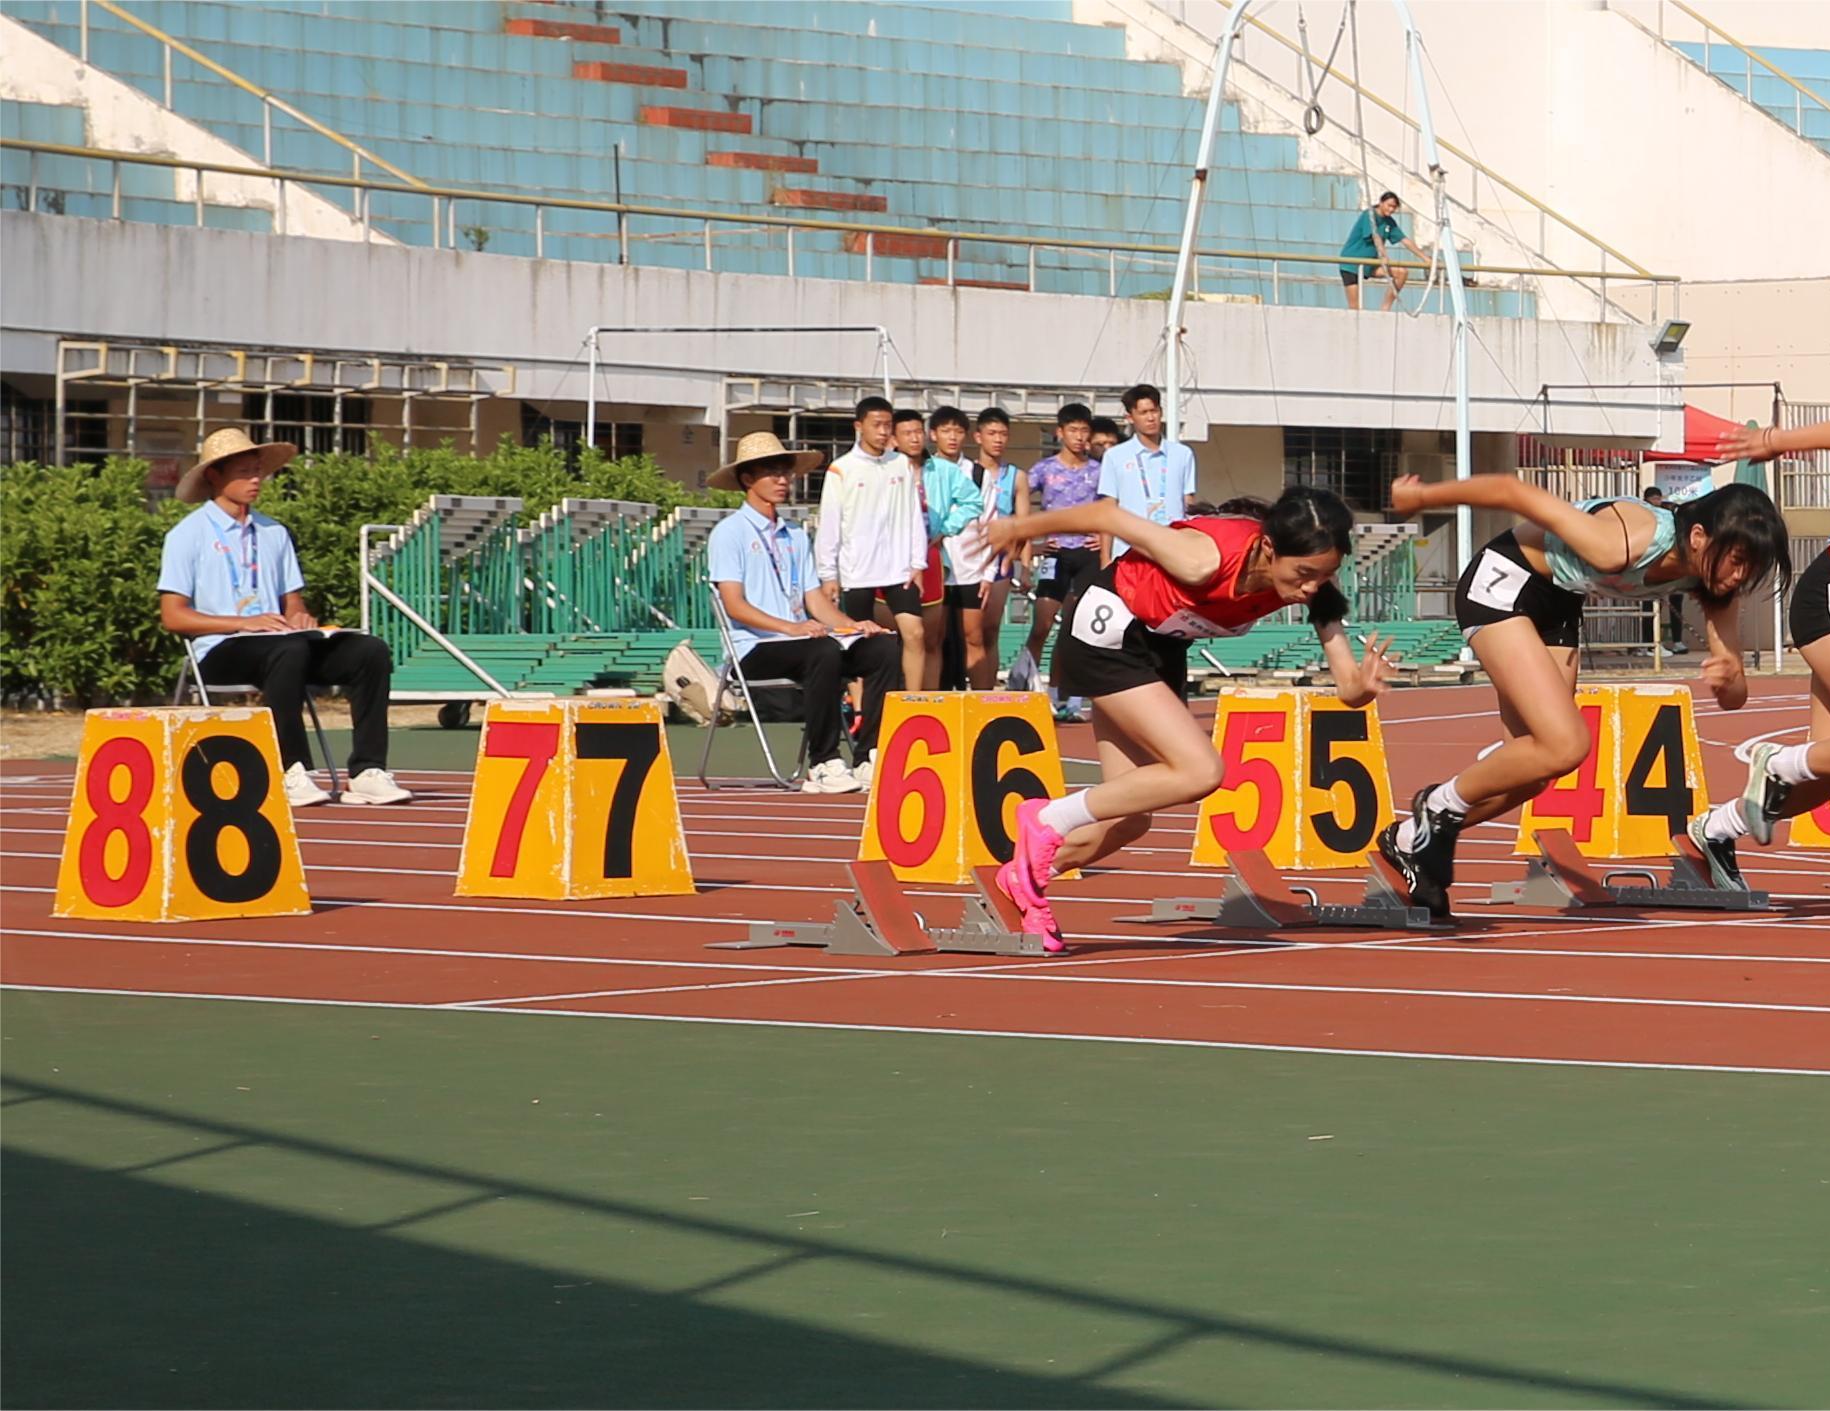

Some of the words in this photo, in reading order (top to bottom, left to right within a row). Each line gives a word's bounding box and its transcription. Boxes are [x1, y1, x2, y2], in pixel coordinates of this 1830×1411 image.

[1668, 486, 1698, 497] 100米
[1090, 604, 1114, 635] 8
[1486, 566, 1509, 593] 7
[79, 737, 155, 907] 8
[182, 735, 282, 904] 8
[485, 721, 561, 878] 7
[575, 723, 661, 879] 7
[877, 714, 951, 868] 6
[972, 716, 1051, 864] 6
[1210, 711, 1286, 852] 5
[1310, 710, 1378, 853] 5
[1532, 706, 1605, 842] 4
[1625, 705, 1694, 840] 4
